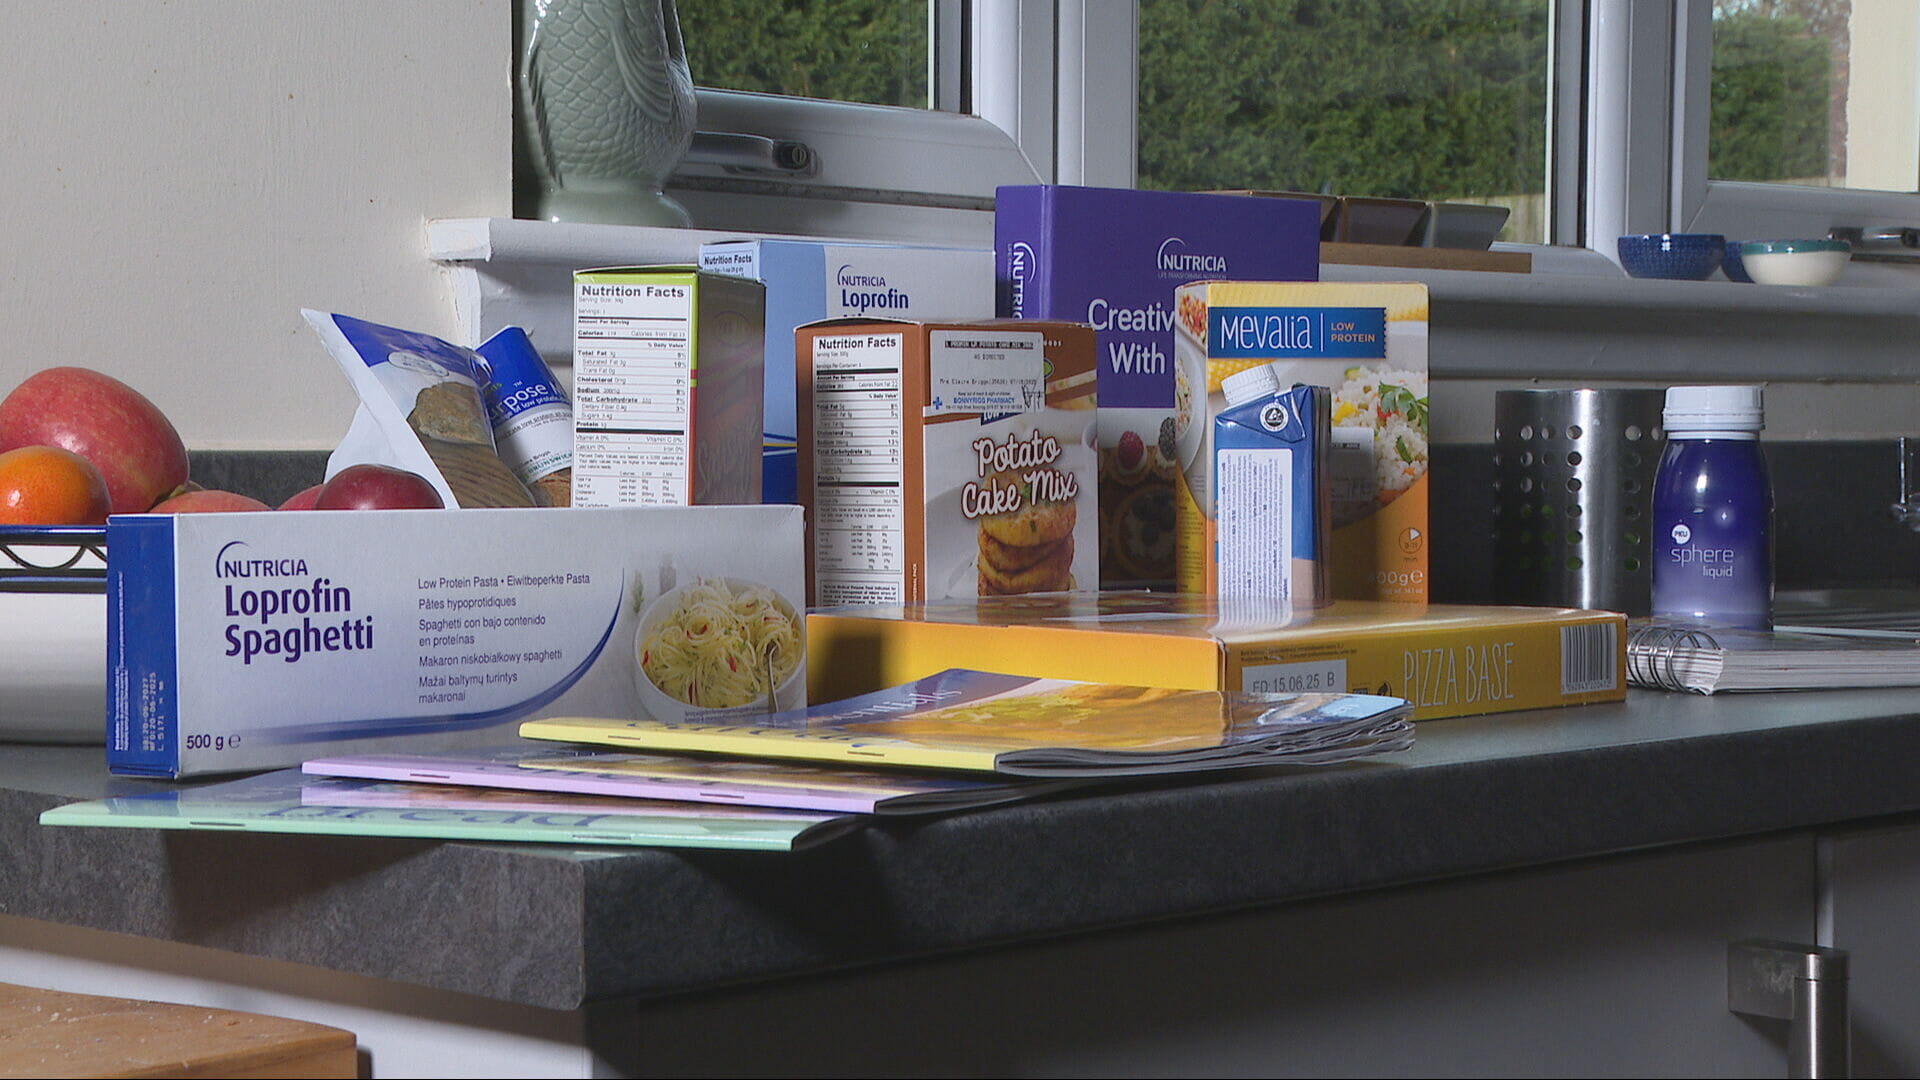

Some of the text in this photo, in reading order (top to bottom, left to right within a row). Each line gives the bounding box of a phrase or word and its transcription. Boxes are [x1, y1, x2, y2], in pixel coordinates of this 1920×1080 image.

[704, 254, 752, 265] Nutrition Facts
[1162, 254, 1227, 272] NUTRICIA
[841, 275, 886, 287] NUTRICIA
[582, 285, 684, 298] Nutrition Facts
[842, 288, 909, 312] Loprofin
[1331, 322, 1355, 331] LOW
[818, 337, 897, 349] Nutrition Facts
[1331, 334, 1376, 342] PROTEIN
[1109, 342, 1165, 374] With
[973, 429, 1062, 478] Potato
[961, 469, 1079, 519] Cake Mix
[1671, 543, 1734, 568] sphere
[224, 559, 308, 578] NUTRICIA
[1702, 565, 1733, 580] liquid
[418, 573, 590, 589] Low Protein Pasta Eiwitbeperkte Pasta
[225, 577, 350, 624] Loprofin
[419, 595, 516, 611] Pâtes hypoprotidiques
[419, 615, 546, 632] Spaghetti con bajo contenido
[225, 615, 373, 665] Spaghetti
[419, 637, 431, 647] en
[419, 655, 458, 668] Makaron
[523, 649, 562, 663] spaghetti
[419, 675, 446, 688] Mažai
[486, 671, 518, 685] turintys
[1327, 671, 1335, 687] B
[1404, 642, 1515, 707] PIZZA BASE
[418, 691, 466, 704] makaronai
[186, 734, 224, 750] 500 g
